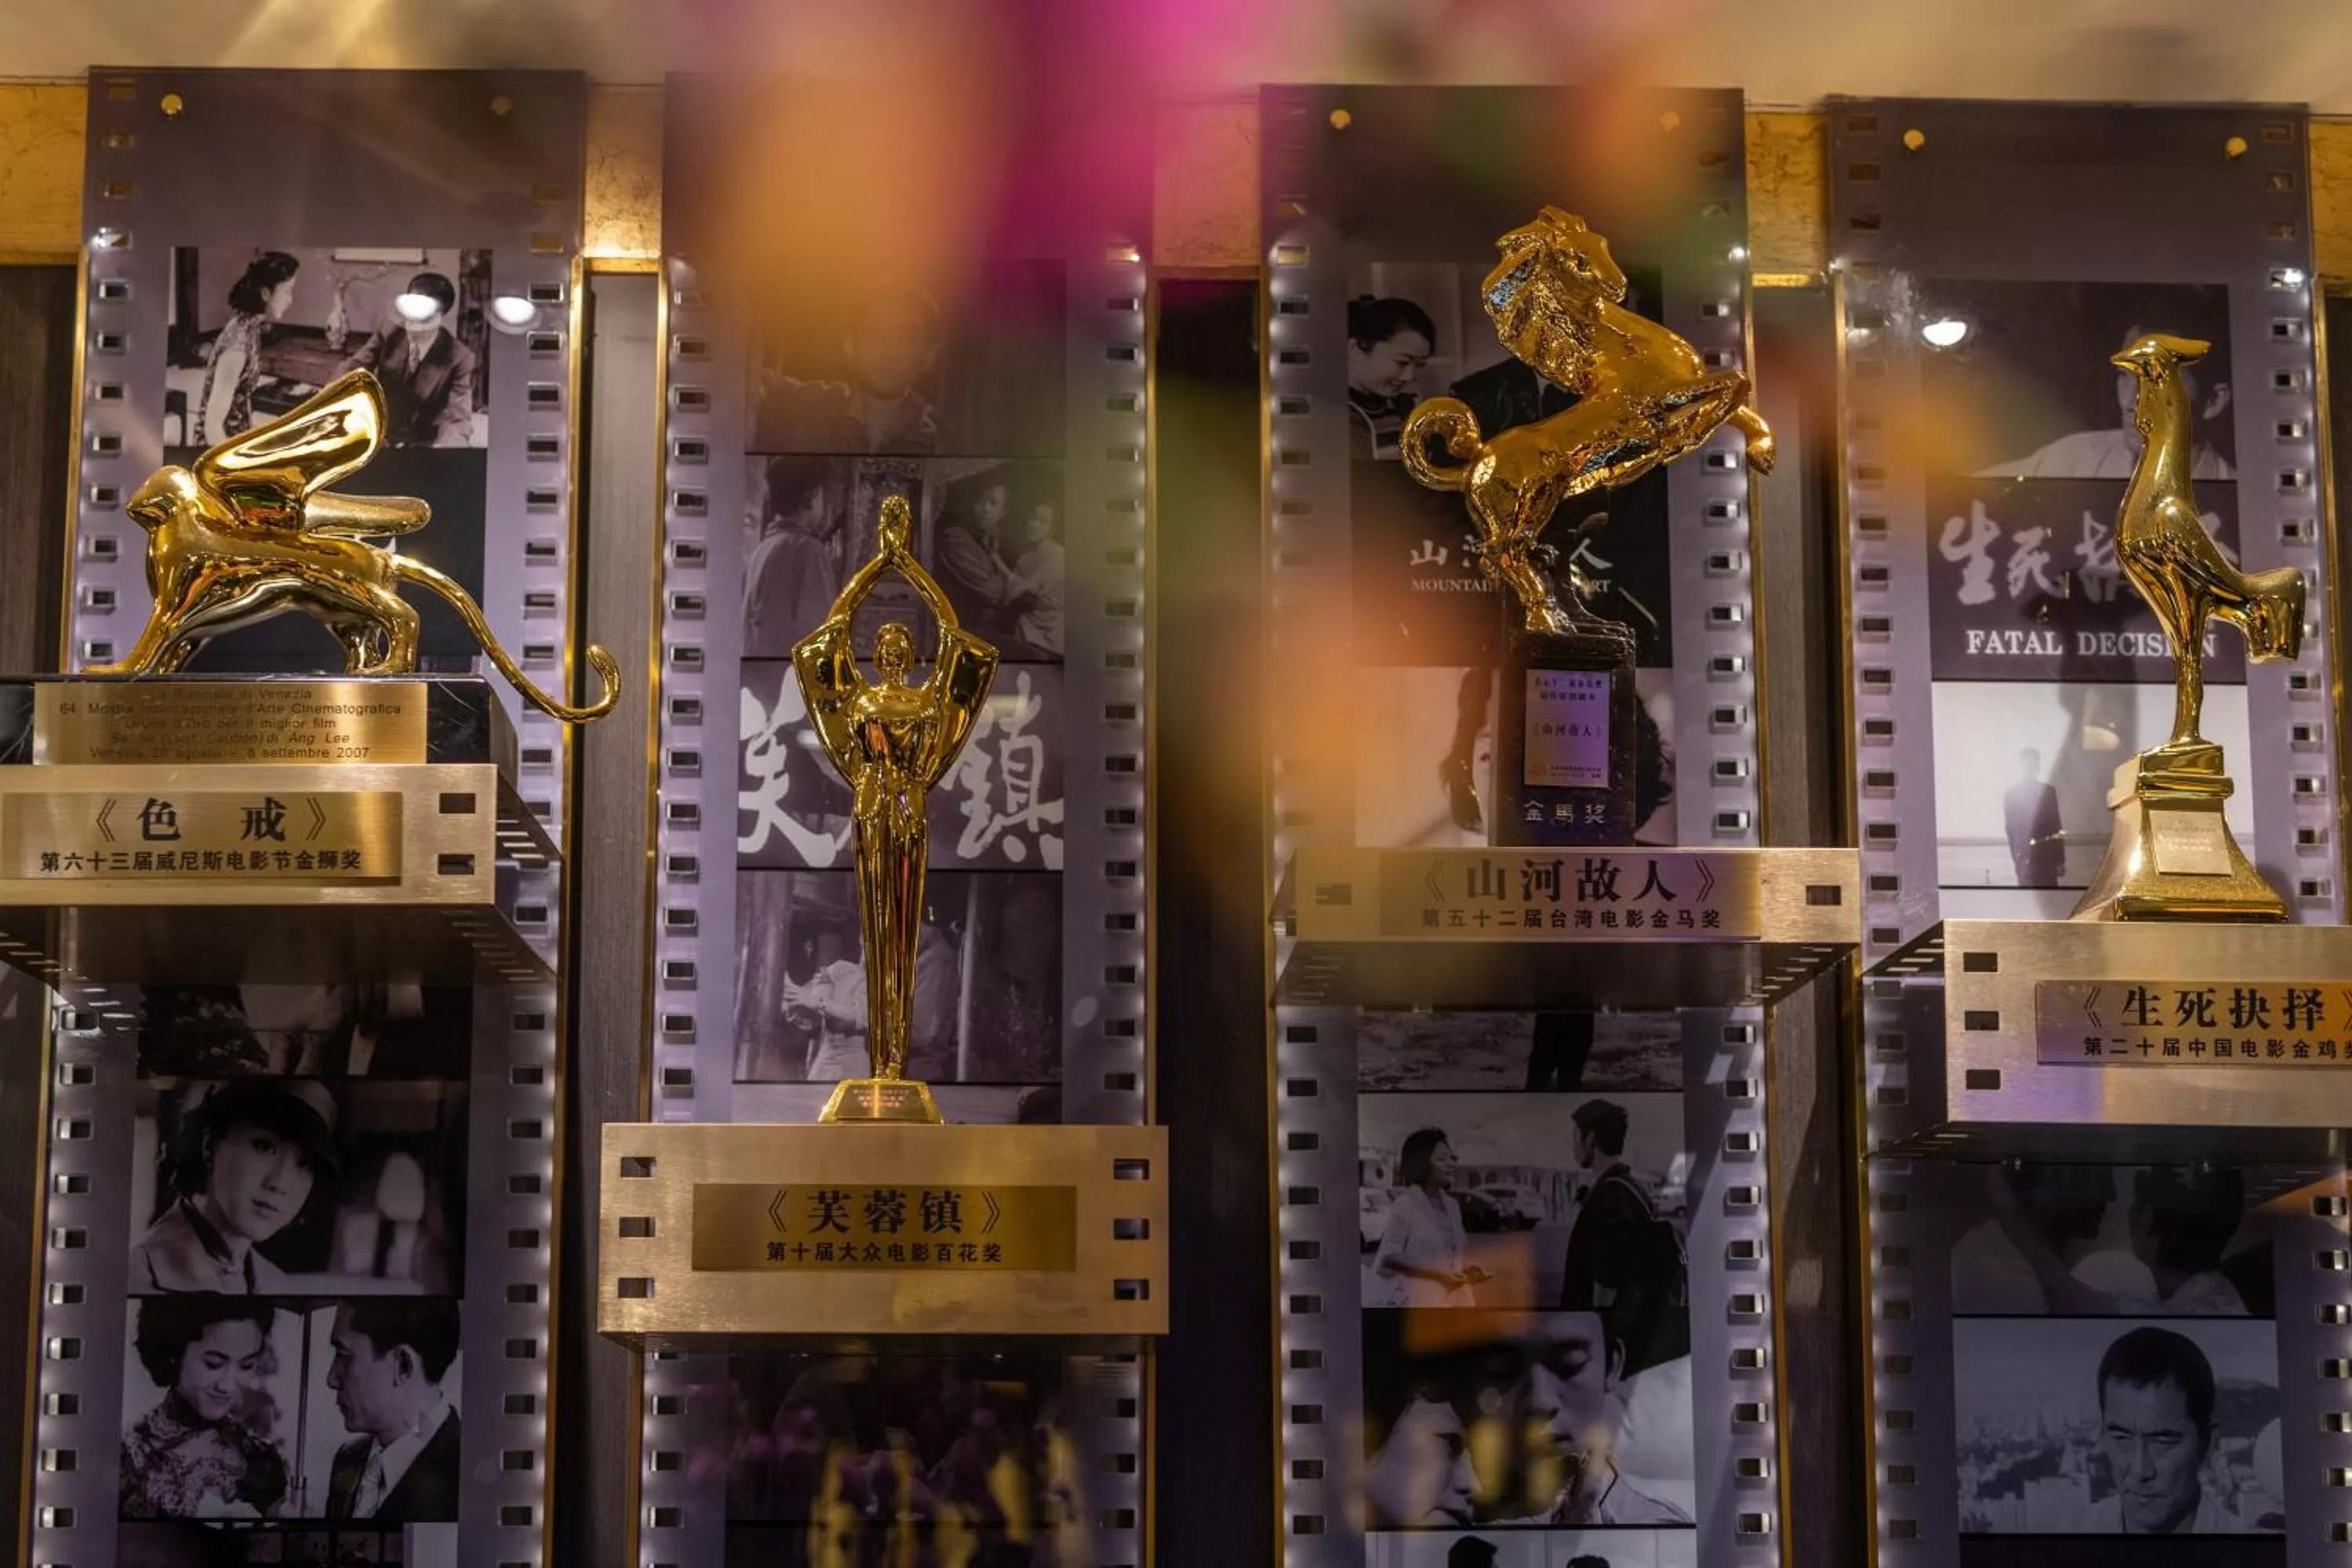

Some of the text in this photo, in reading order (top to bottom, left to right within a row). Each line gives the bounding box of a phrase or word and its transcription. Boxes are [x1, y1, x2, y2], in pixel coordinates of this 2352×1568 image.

[1410, 534, 1613, 568] 山人
[1966, 630, 2218, 659] FATAL DECISIN
[259, 689, 312, 699] Venezia
[291, 703, 401, 717] Cinematografica
[313, 718, 336, 728] film
[288, 731, 316, 745] Ang
[325, 731, 350, 743] Lee
[262, 747, 330, 758] settembre
[336, 747, 370, 758] 2007
[40, 851, 361, 871] 第六十三届威尼斯电影节金狮奖
[1425, 858, 1716, 903] 《山河故人》
[1421, 909, 1721, 929] 第五十二届台湾电影金马奖
[768, 1189, 1001, 1234] 《芙蓉镇》
[766, 1241, 1002, 1263] 第十届大众电影百花奖
